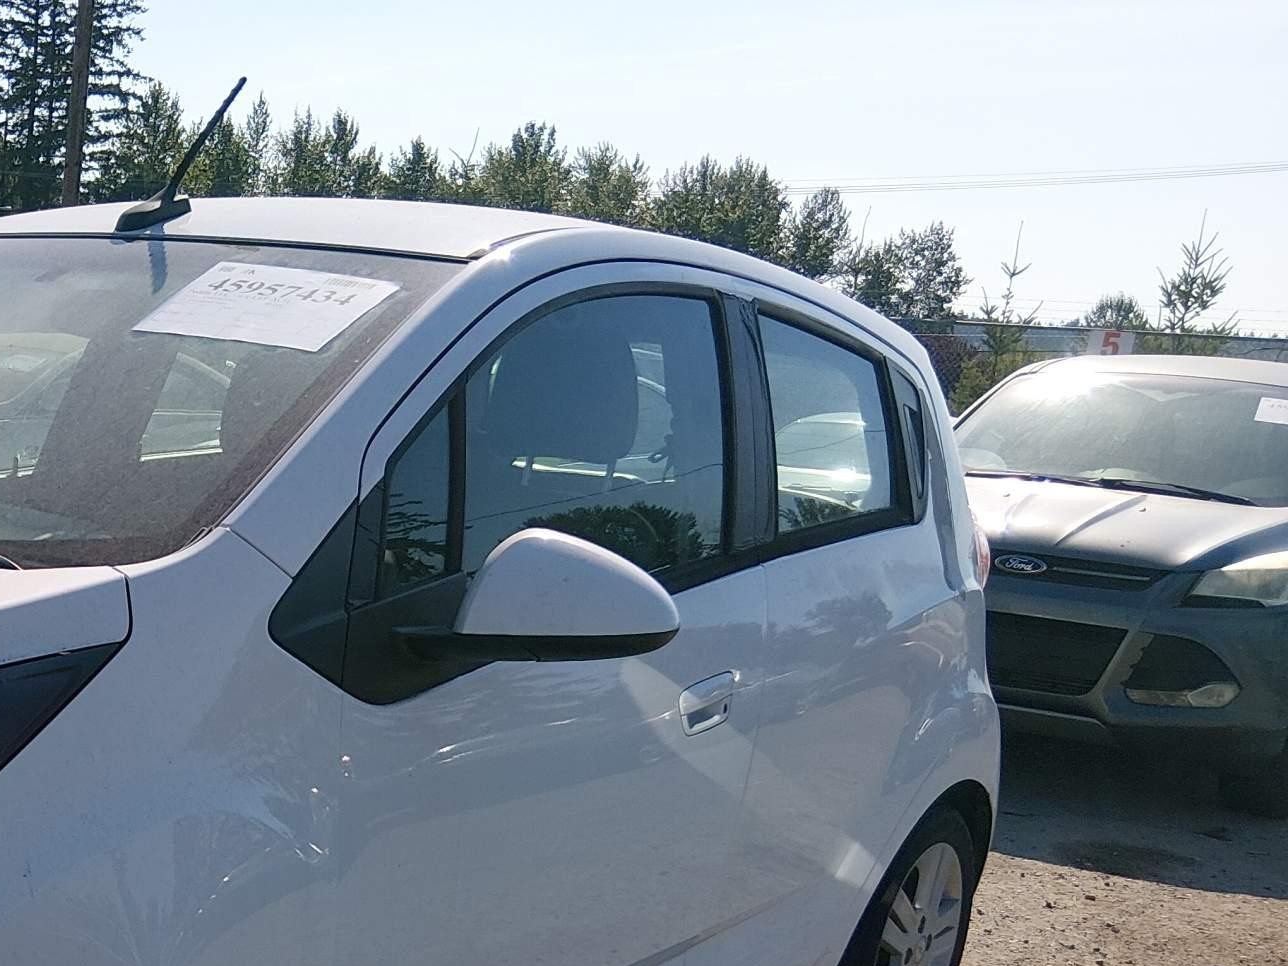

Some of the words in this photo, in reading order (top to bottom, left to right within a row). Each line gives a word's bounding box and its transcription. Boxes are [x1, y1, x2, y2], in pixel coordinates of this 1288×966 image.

[207, 277, 358, 306] 45957434
[1100, 331, 1121, 356] 5
[1004, 557, 1035, 571] Ford
